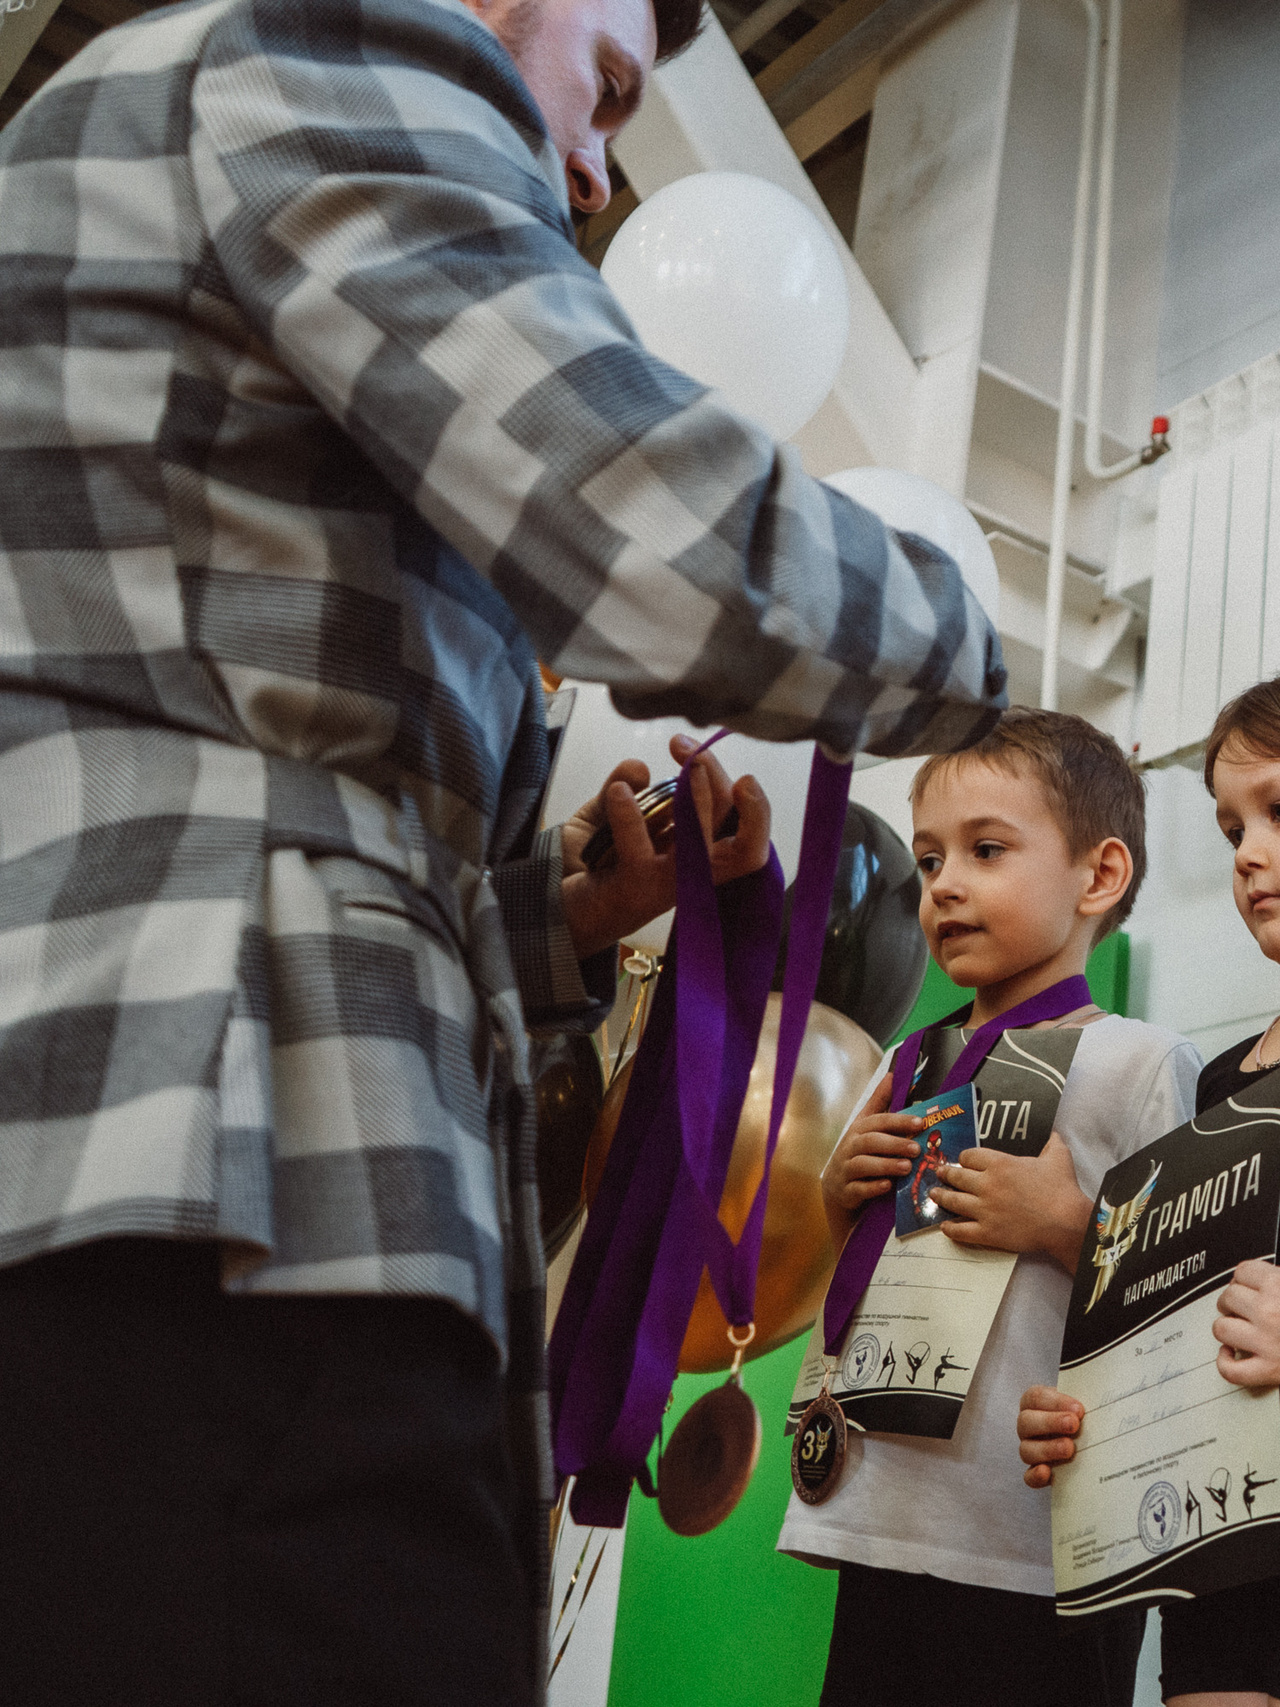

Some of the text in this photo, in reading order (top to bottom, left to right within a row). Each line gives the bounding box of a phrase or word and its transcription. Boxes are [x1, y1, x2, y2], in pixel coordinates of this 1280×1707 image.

[922, 1104, 965, 1130] ОВЕК-ПАУК
[1142, 1153, 1261, 1252] ГРАМОТА
[1123, 1250, 1206, 1306] НАГРАЖДАЕТСЯ
[801, 1430, 816, 1460] 3
